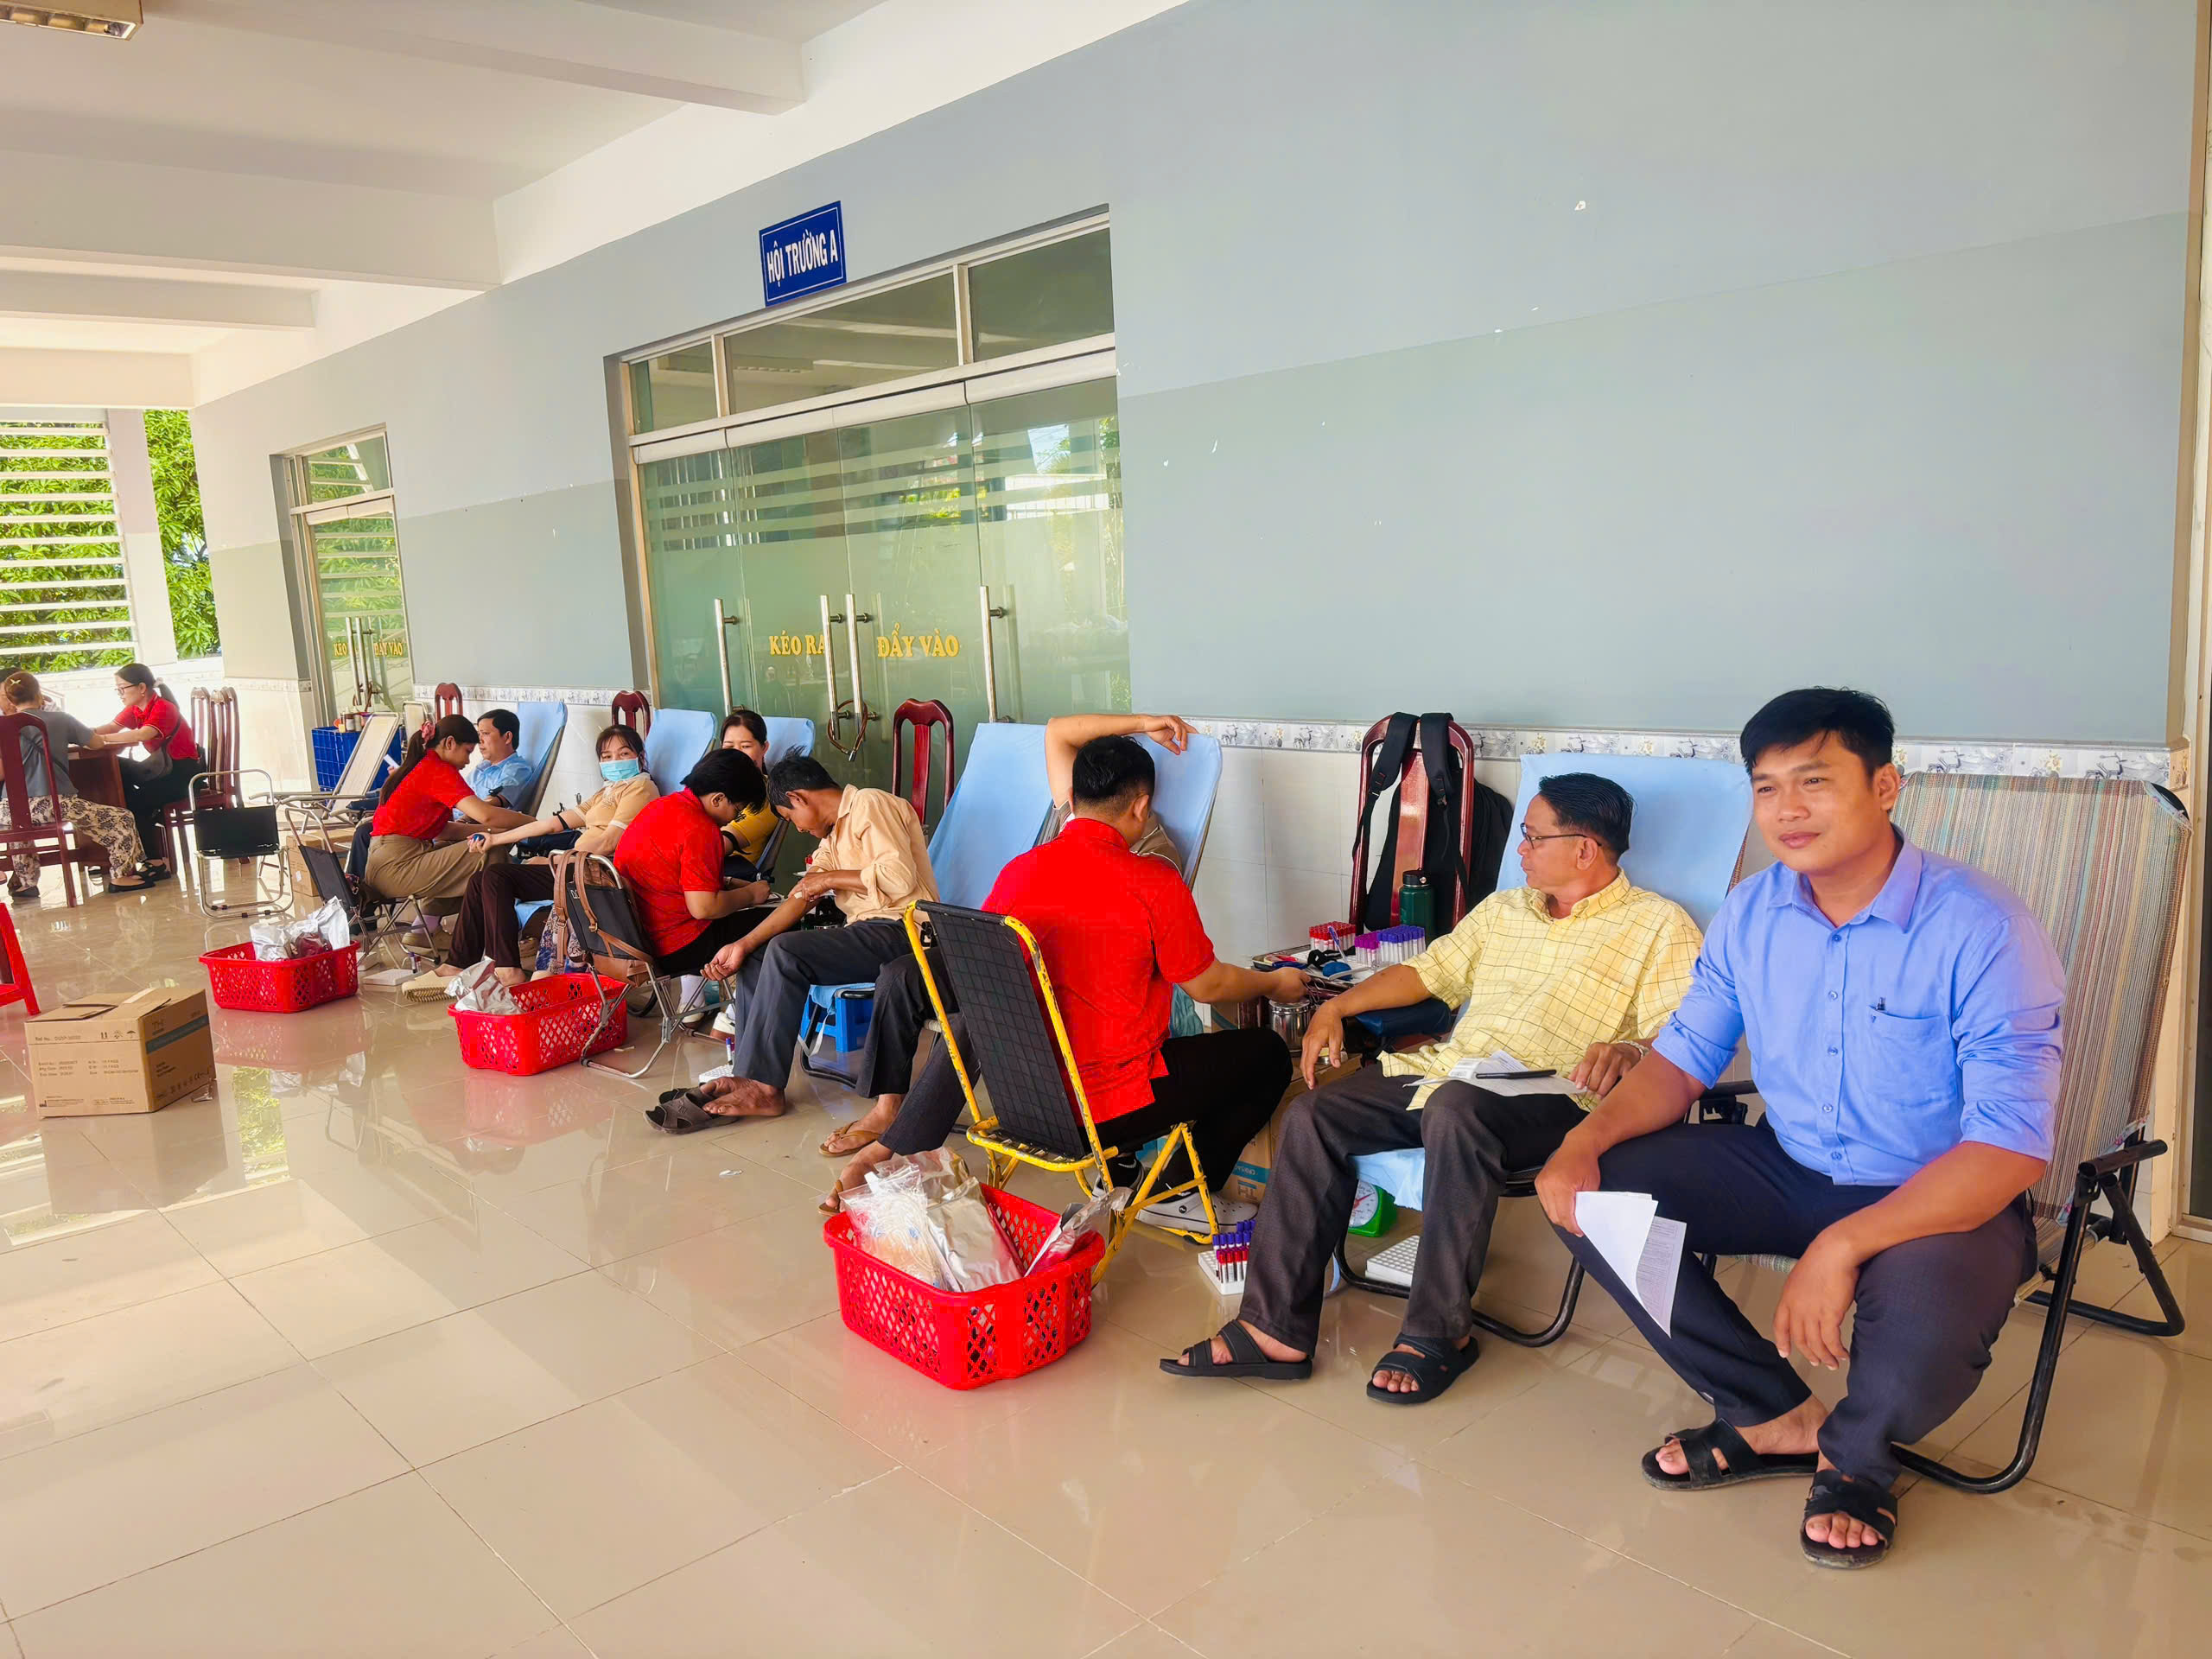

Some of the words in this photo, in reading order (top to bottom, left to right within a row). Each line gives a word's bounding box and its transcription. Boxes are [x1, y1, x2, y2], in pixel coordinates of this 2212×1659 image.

[766, 240, 785, 287] HỘI
[785, 229, 828, 276] TRƯỜNG
[830, 229, 838, 263] A
[769, 630, 803, 656] KÉO
[877, 623, 915, 658] ĐẨY
[918, 628, 960, 658] VÀO
